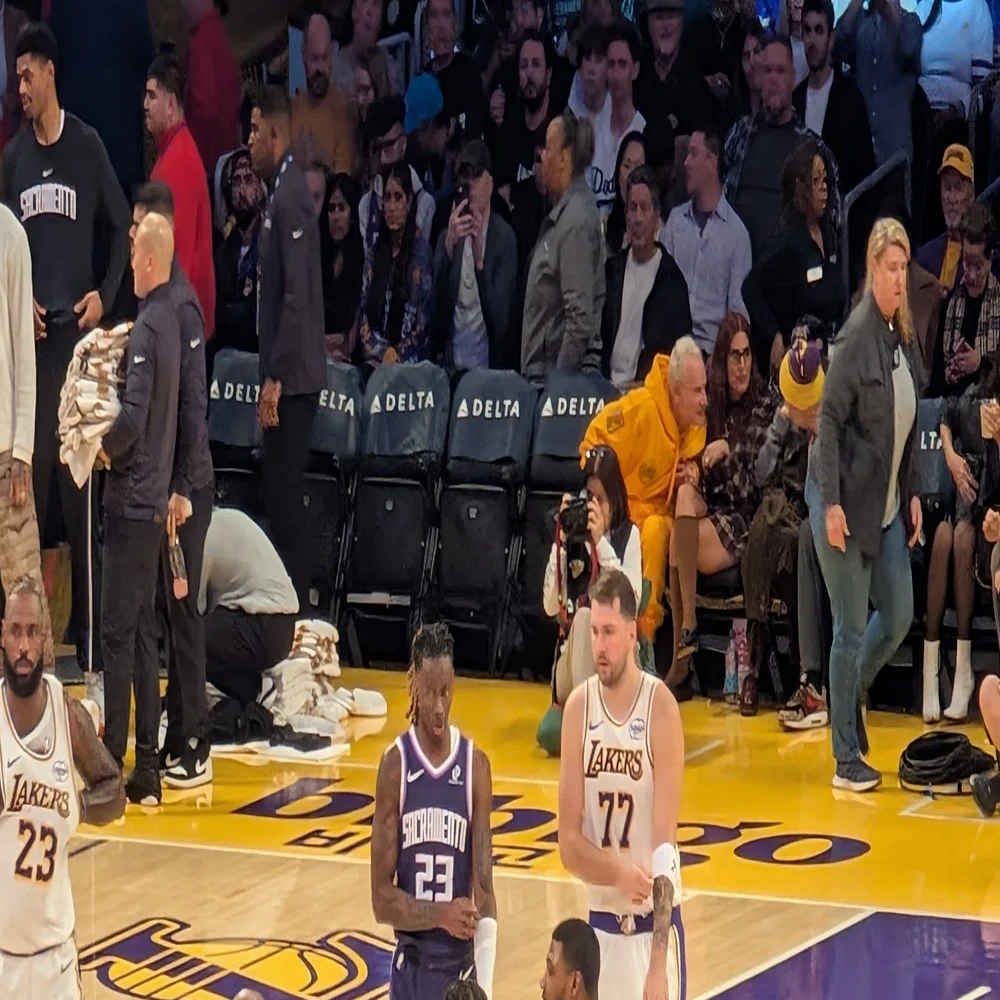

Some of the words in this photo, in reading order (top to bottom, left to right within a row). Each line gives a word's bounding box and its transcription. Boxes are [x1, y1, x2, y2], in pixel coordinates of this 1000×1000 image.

[224, 382, 260, 403] DELT
[319, 389, 355, 416] ELTA
[386, 390, 434, 412] DELTA
[472, 398, 520, 418] DELTA
[557, 396, 604, 416] DELTA
[585, 739, 643, 781] LAKERS
[7, 773, 70, 818] LAKERS
[402, 807, 468, 853] SACRAMENTO
[598, 791, 634, 849] 77
[14, 818, 58, 884] 23
[415, 853, 455, 902] 23
